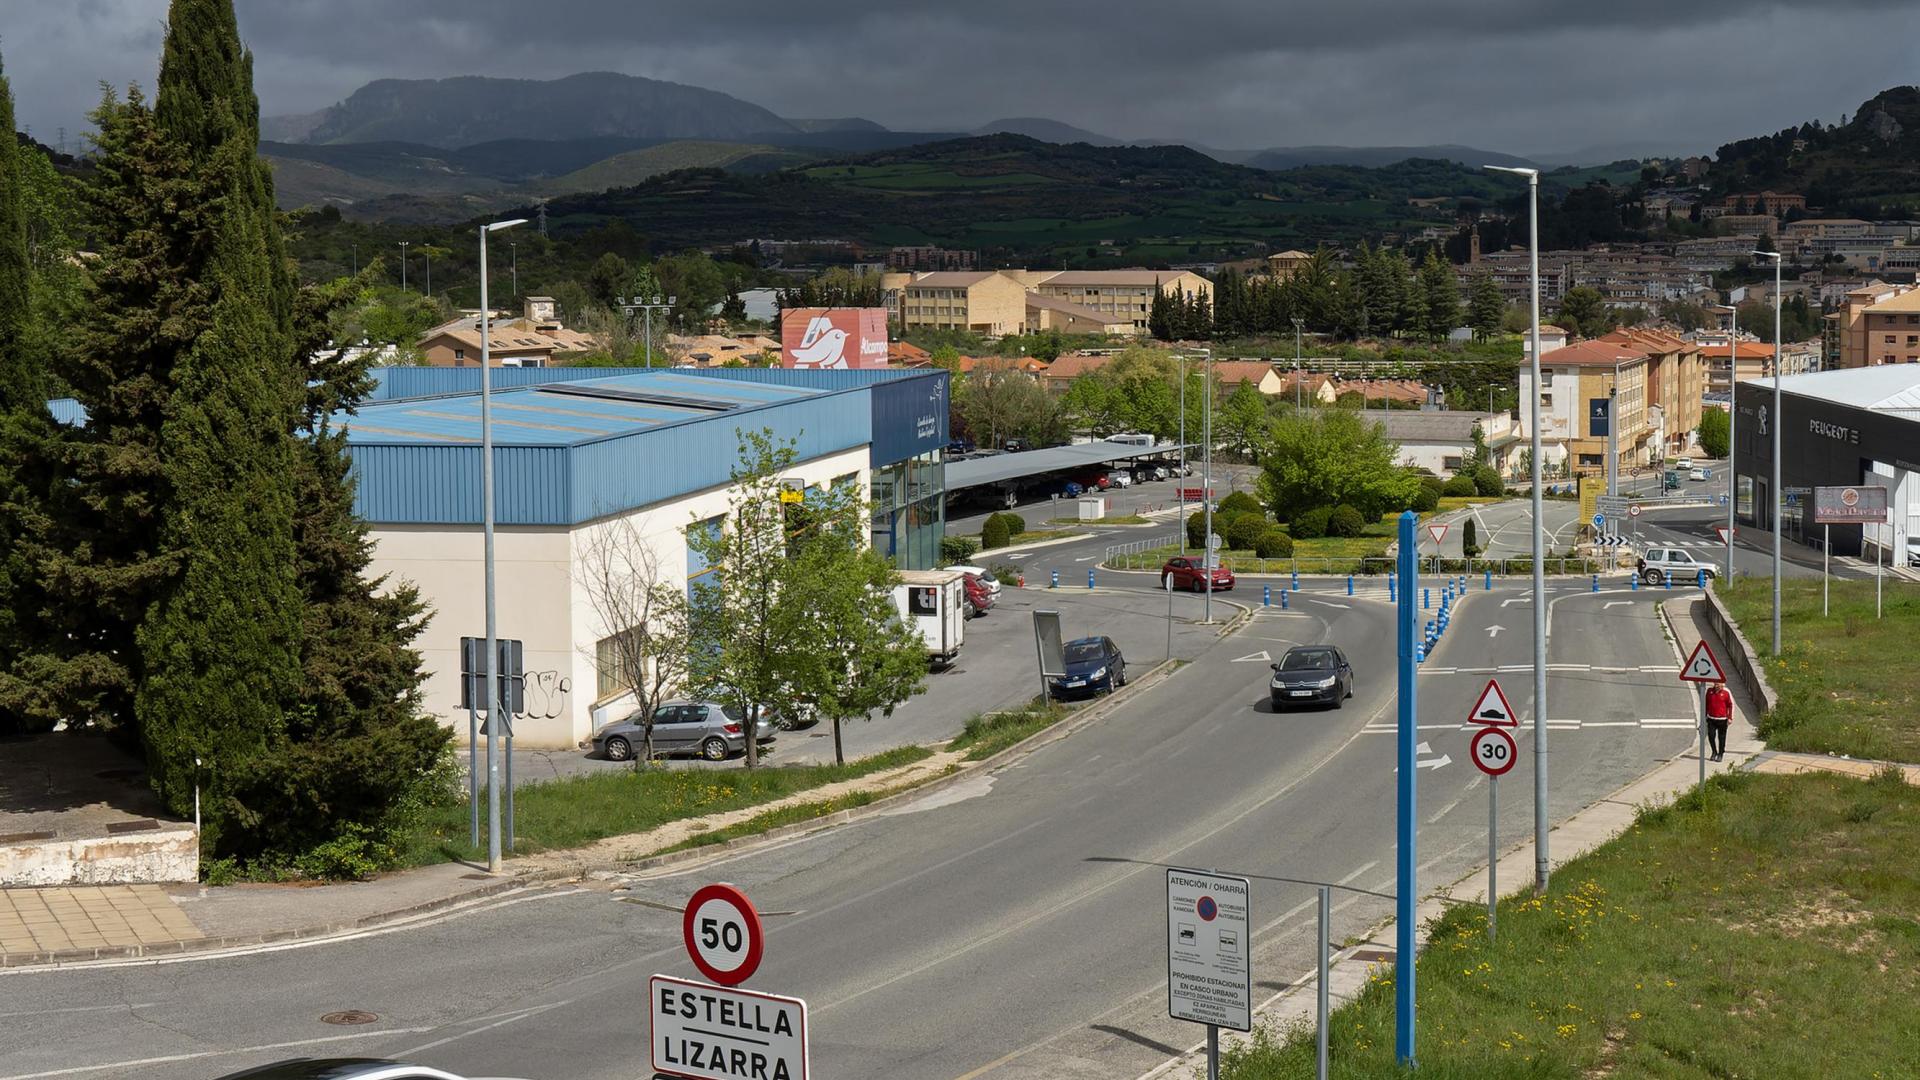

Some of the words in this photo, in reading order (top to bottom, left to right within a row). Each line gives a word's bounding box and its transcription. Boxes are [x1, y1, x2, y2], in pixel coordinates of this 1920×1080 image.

[1809, 419, 1848, 441] PEUGEOT
[1482, 743, 1507, 760] 30
[1170, 877, 1207, 889] ATENCIÓN
[1213, 884, 1246, 895] OHARRA
[701, 918, 742, 953] 50
[1172, 971, 1206, 983] PROHIBIDO
[1207, 977, 1246, 990] ESTACIONAR
[1189, 984, 1211, 994] CASCO
[1212, 988, 1239, 999] URBANO
[660, 988, 793, 1037] ESTELLA
[664, 1036, 791, 1080] LIZARRA
